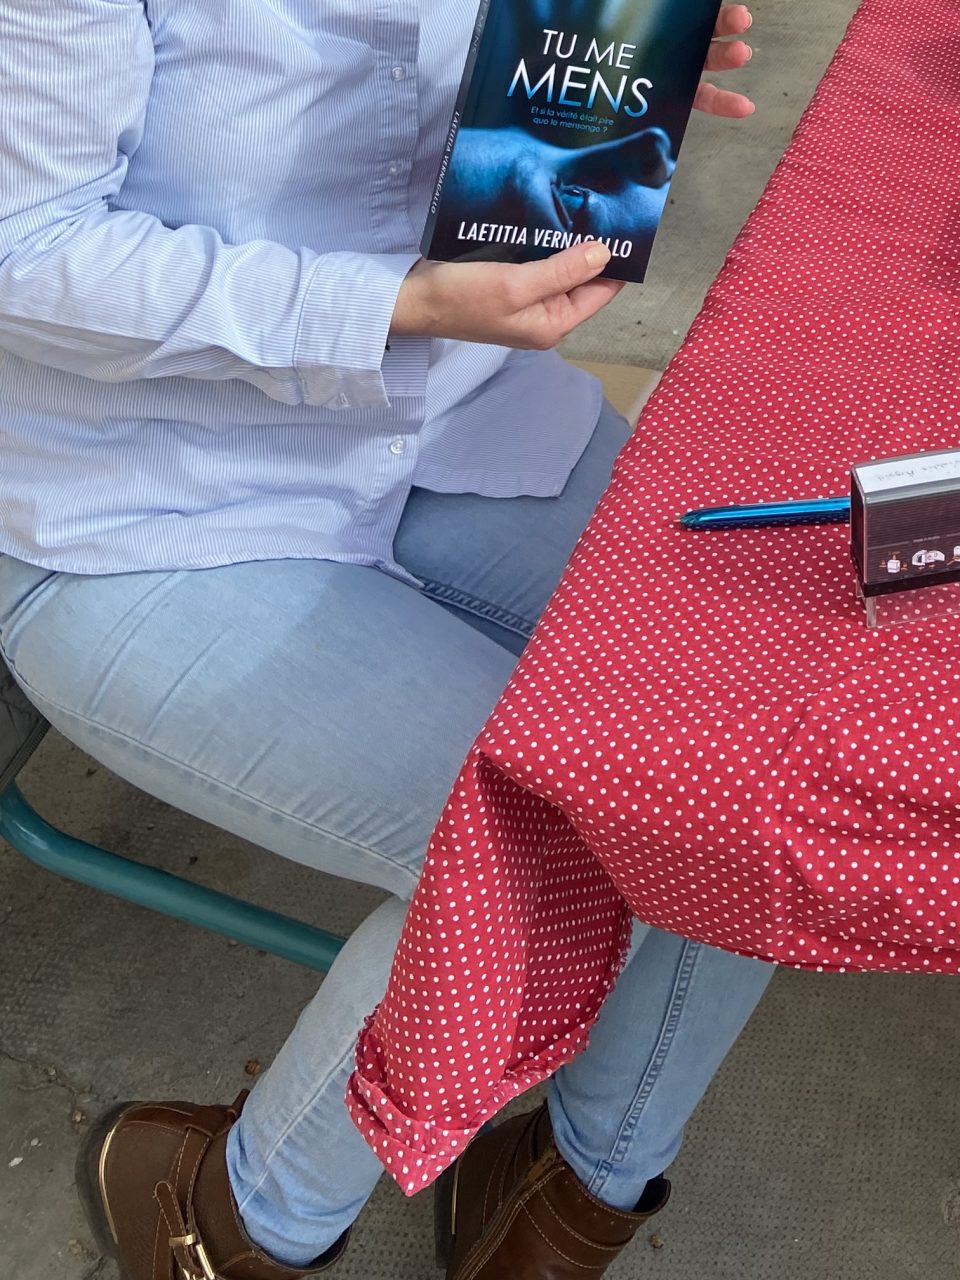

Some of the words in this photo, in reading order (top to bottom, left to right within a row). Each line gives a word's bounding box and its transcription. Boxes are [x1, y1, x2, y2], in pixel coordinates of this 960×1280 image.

[543, 29, 578, 58] TU
[584, 38, 636, 70] ME
[507, 58, 654, 118] MENS
[446, 111, 460, 152] LAETITIA
[530, 106, 538, 114] Et
[540, 107, 546, 115] si
[547, 108, 555, 116] la
[556, 110, 578, 119] vérité
[580, 113, 598, 122] était
[598, 116, 614, 126] pire
[533, 118, 549, 126] que
[560, 121, 600, 133] mensonge
[431, 156, 449, 214] VERNAGALLO
[458, 222, 527, 245] LAETITIA
